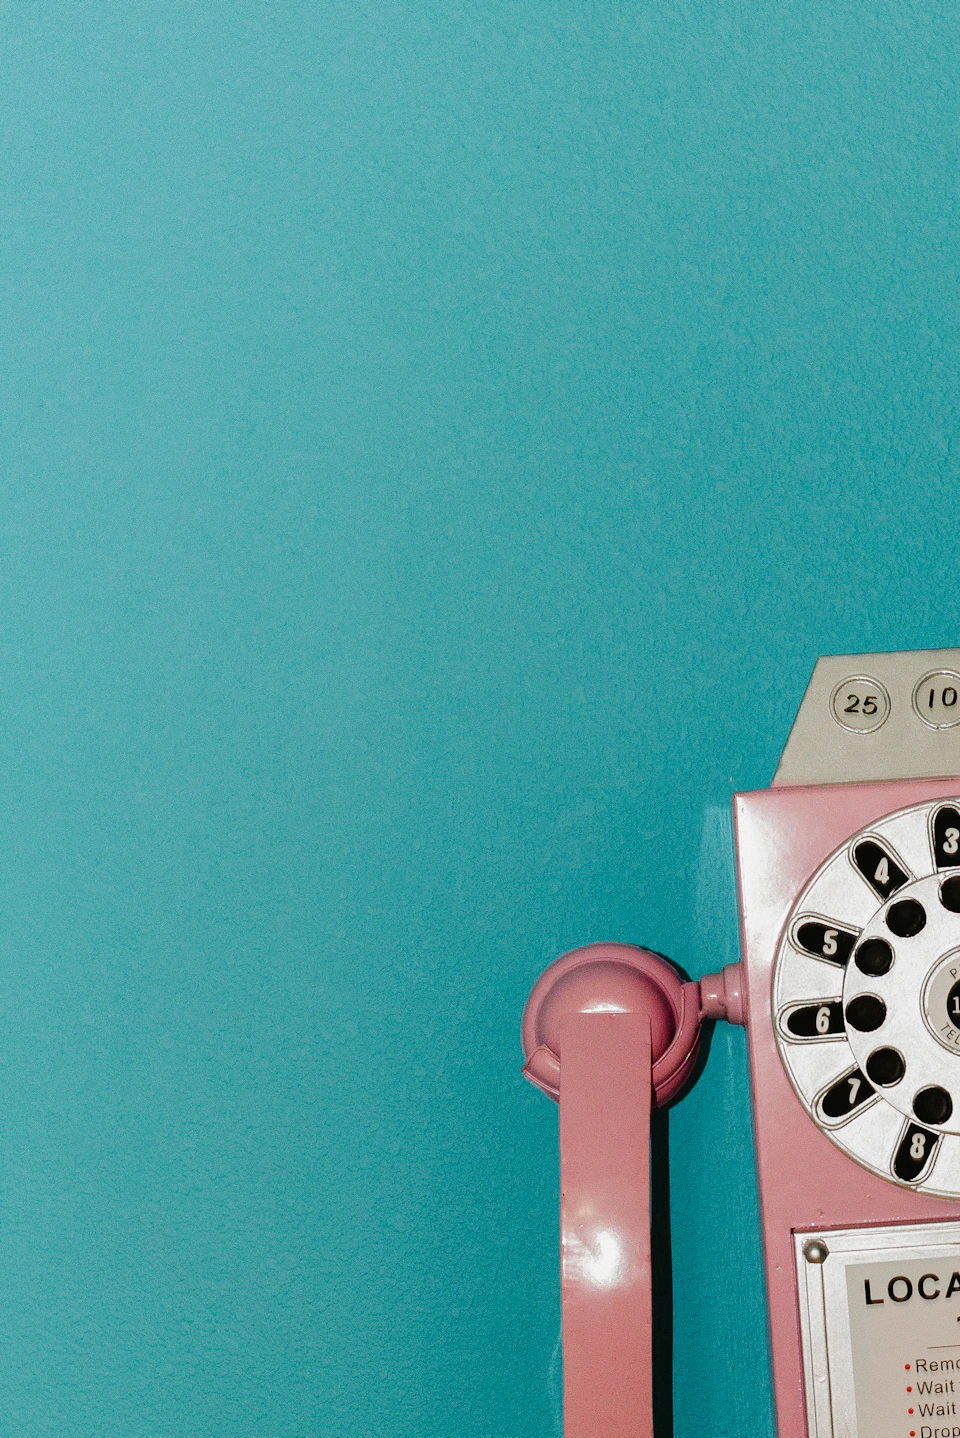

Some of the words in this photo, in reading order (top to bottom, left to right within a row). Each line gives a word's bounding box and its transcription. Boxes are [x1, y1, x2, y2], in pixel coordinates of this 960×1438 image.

[843, 693, 878, 715] 25
[928, 687, 959, 709] 10
[942, 827, 960, 854] 3
[874, 858, 890, 884] 4
[822, 930, 838, 955] 5
[815, 1007, 831, 1034] 6
[848, 1078, 861, 1104] 7
[909, 1132, 926, 1159] 8
[917, 1379, 955, 1395] Wait
[918, 1402, 957, 1418] Wait
